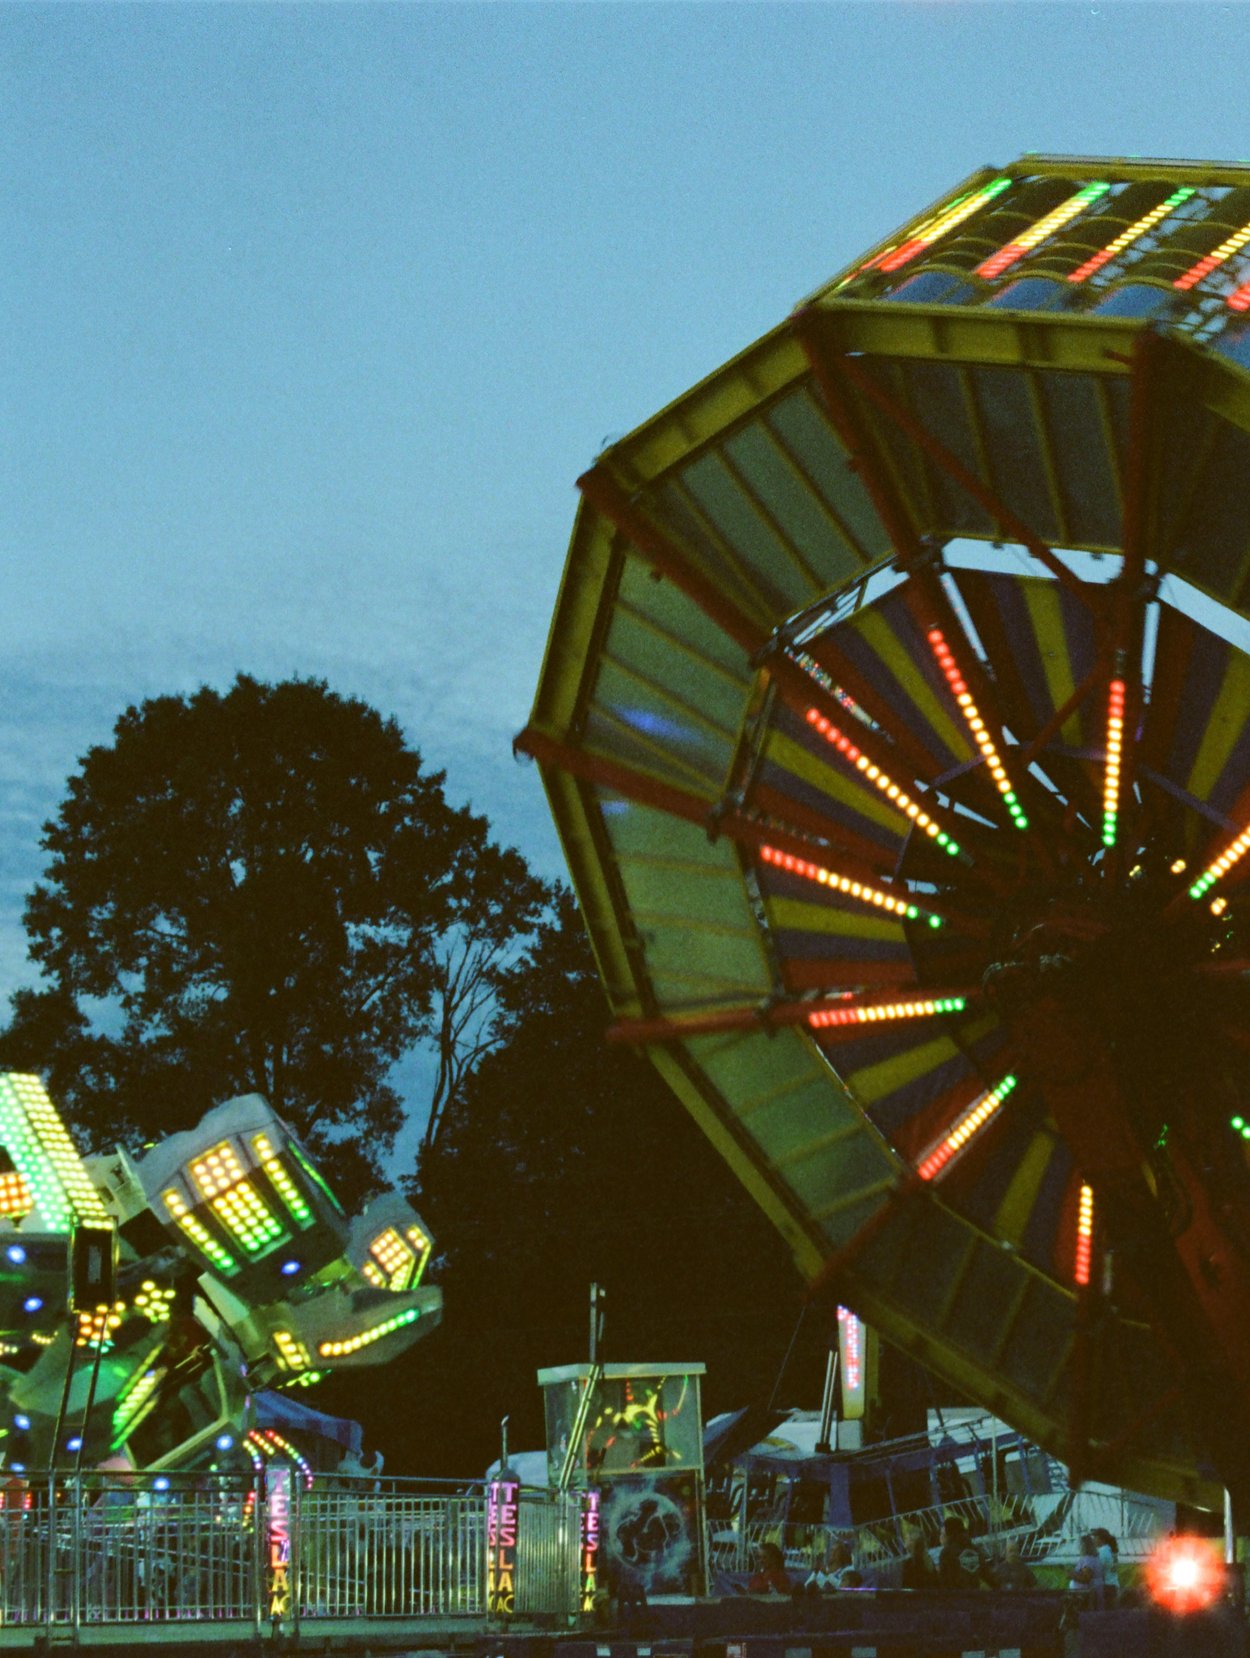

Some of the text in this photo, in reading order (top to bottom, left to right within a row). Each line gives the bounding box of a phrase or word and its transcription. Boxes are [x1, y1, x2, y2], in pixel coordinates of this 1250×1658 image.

[270, 1470, 290, 1592] TESLA
[498, 1482, 519, 1592] TESLA
[585, 1491, 600, 1593] TESLA
